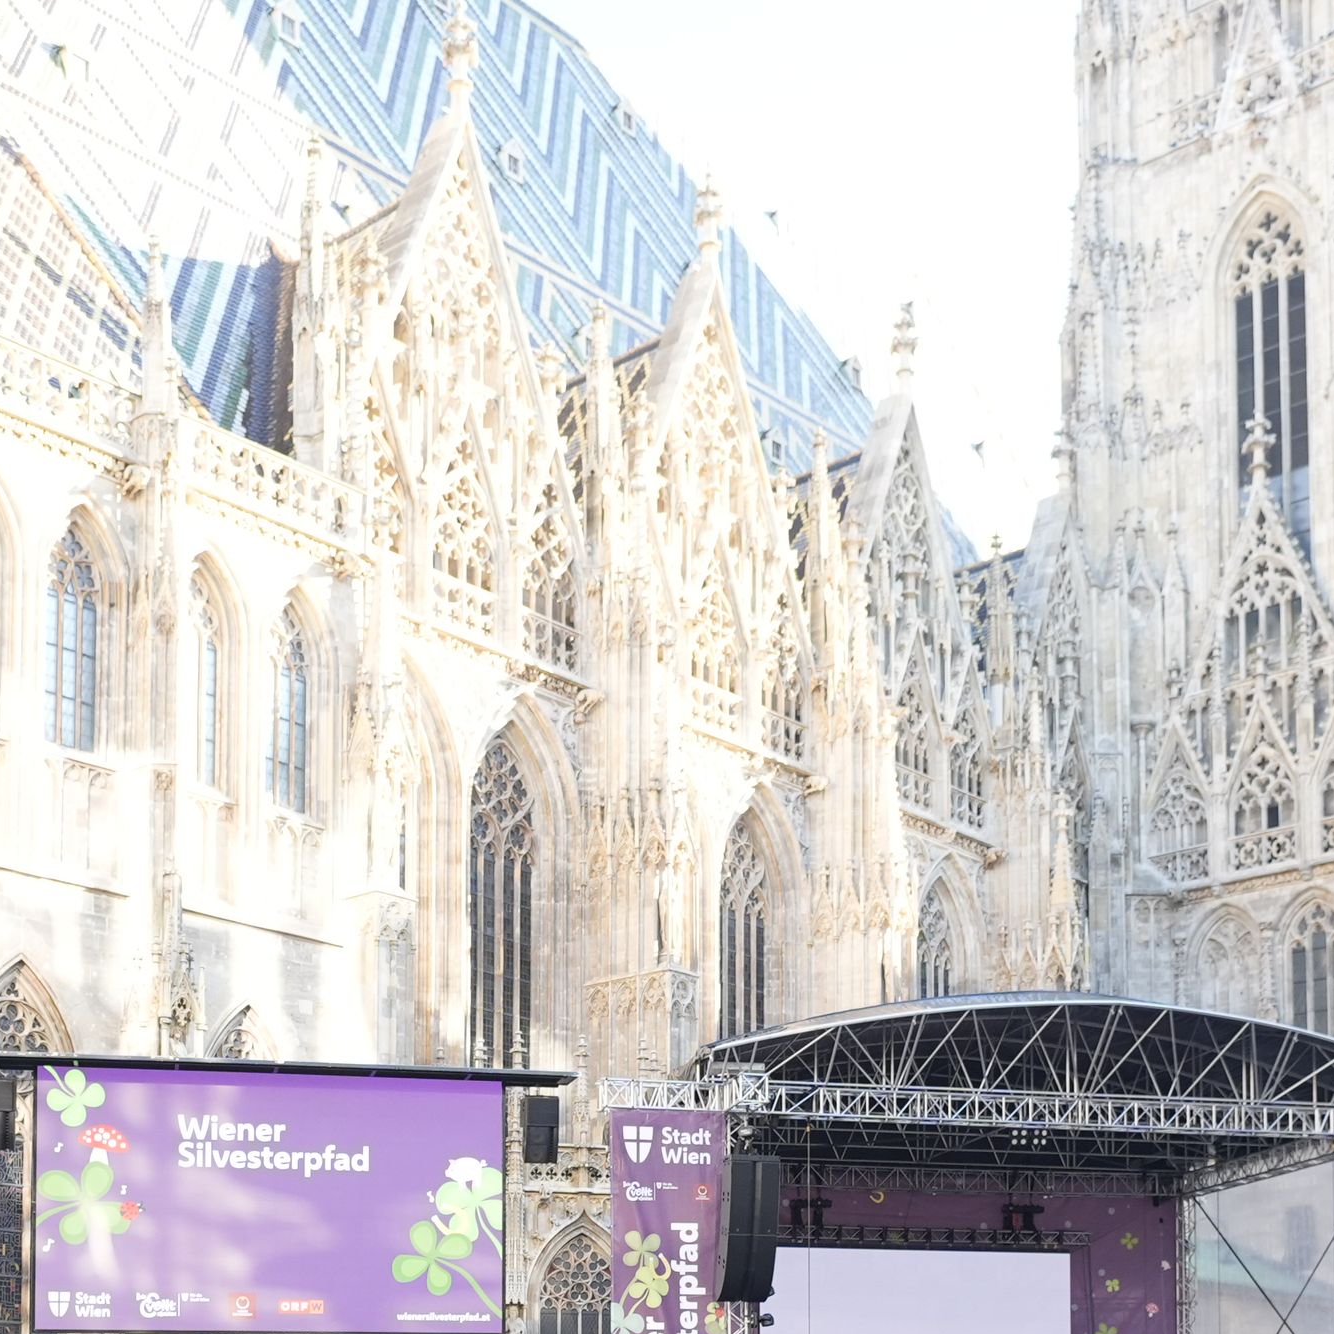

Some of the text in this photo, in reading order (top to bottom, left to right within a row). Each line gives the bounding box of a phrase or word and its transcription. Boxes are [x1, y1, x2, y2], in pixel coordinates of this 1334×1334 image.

[177, 1114, 287, 1142] Wiener
[661, 1126, 712, 1146] Stadt
[177, 1141, 370, 1178] Silvesterpfad
[661, 1146, 711, 1165] Wien
[75, 1291, 112, 1305] Stadt
[281, 1301, 309, 1311] ORF
[75, 1305, 111, 1318] Wien
